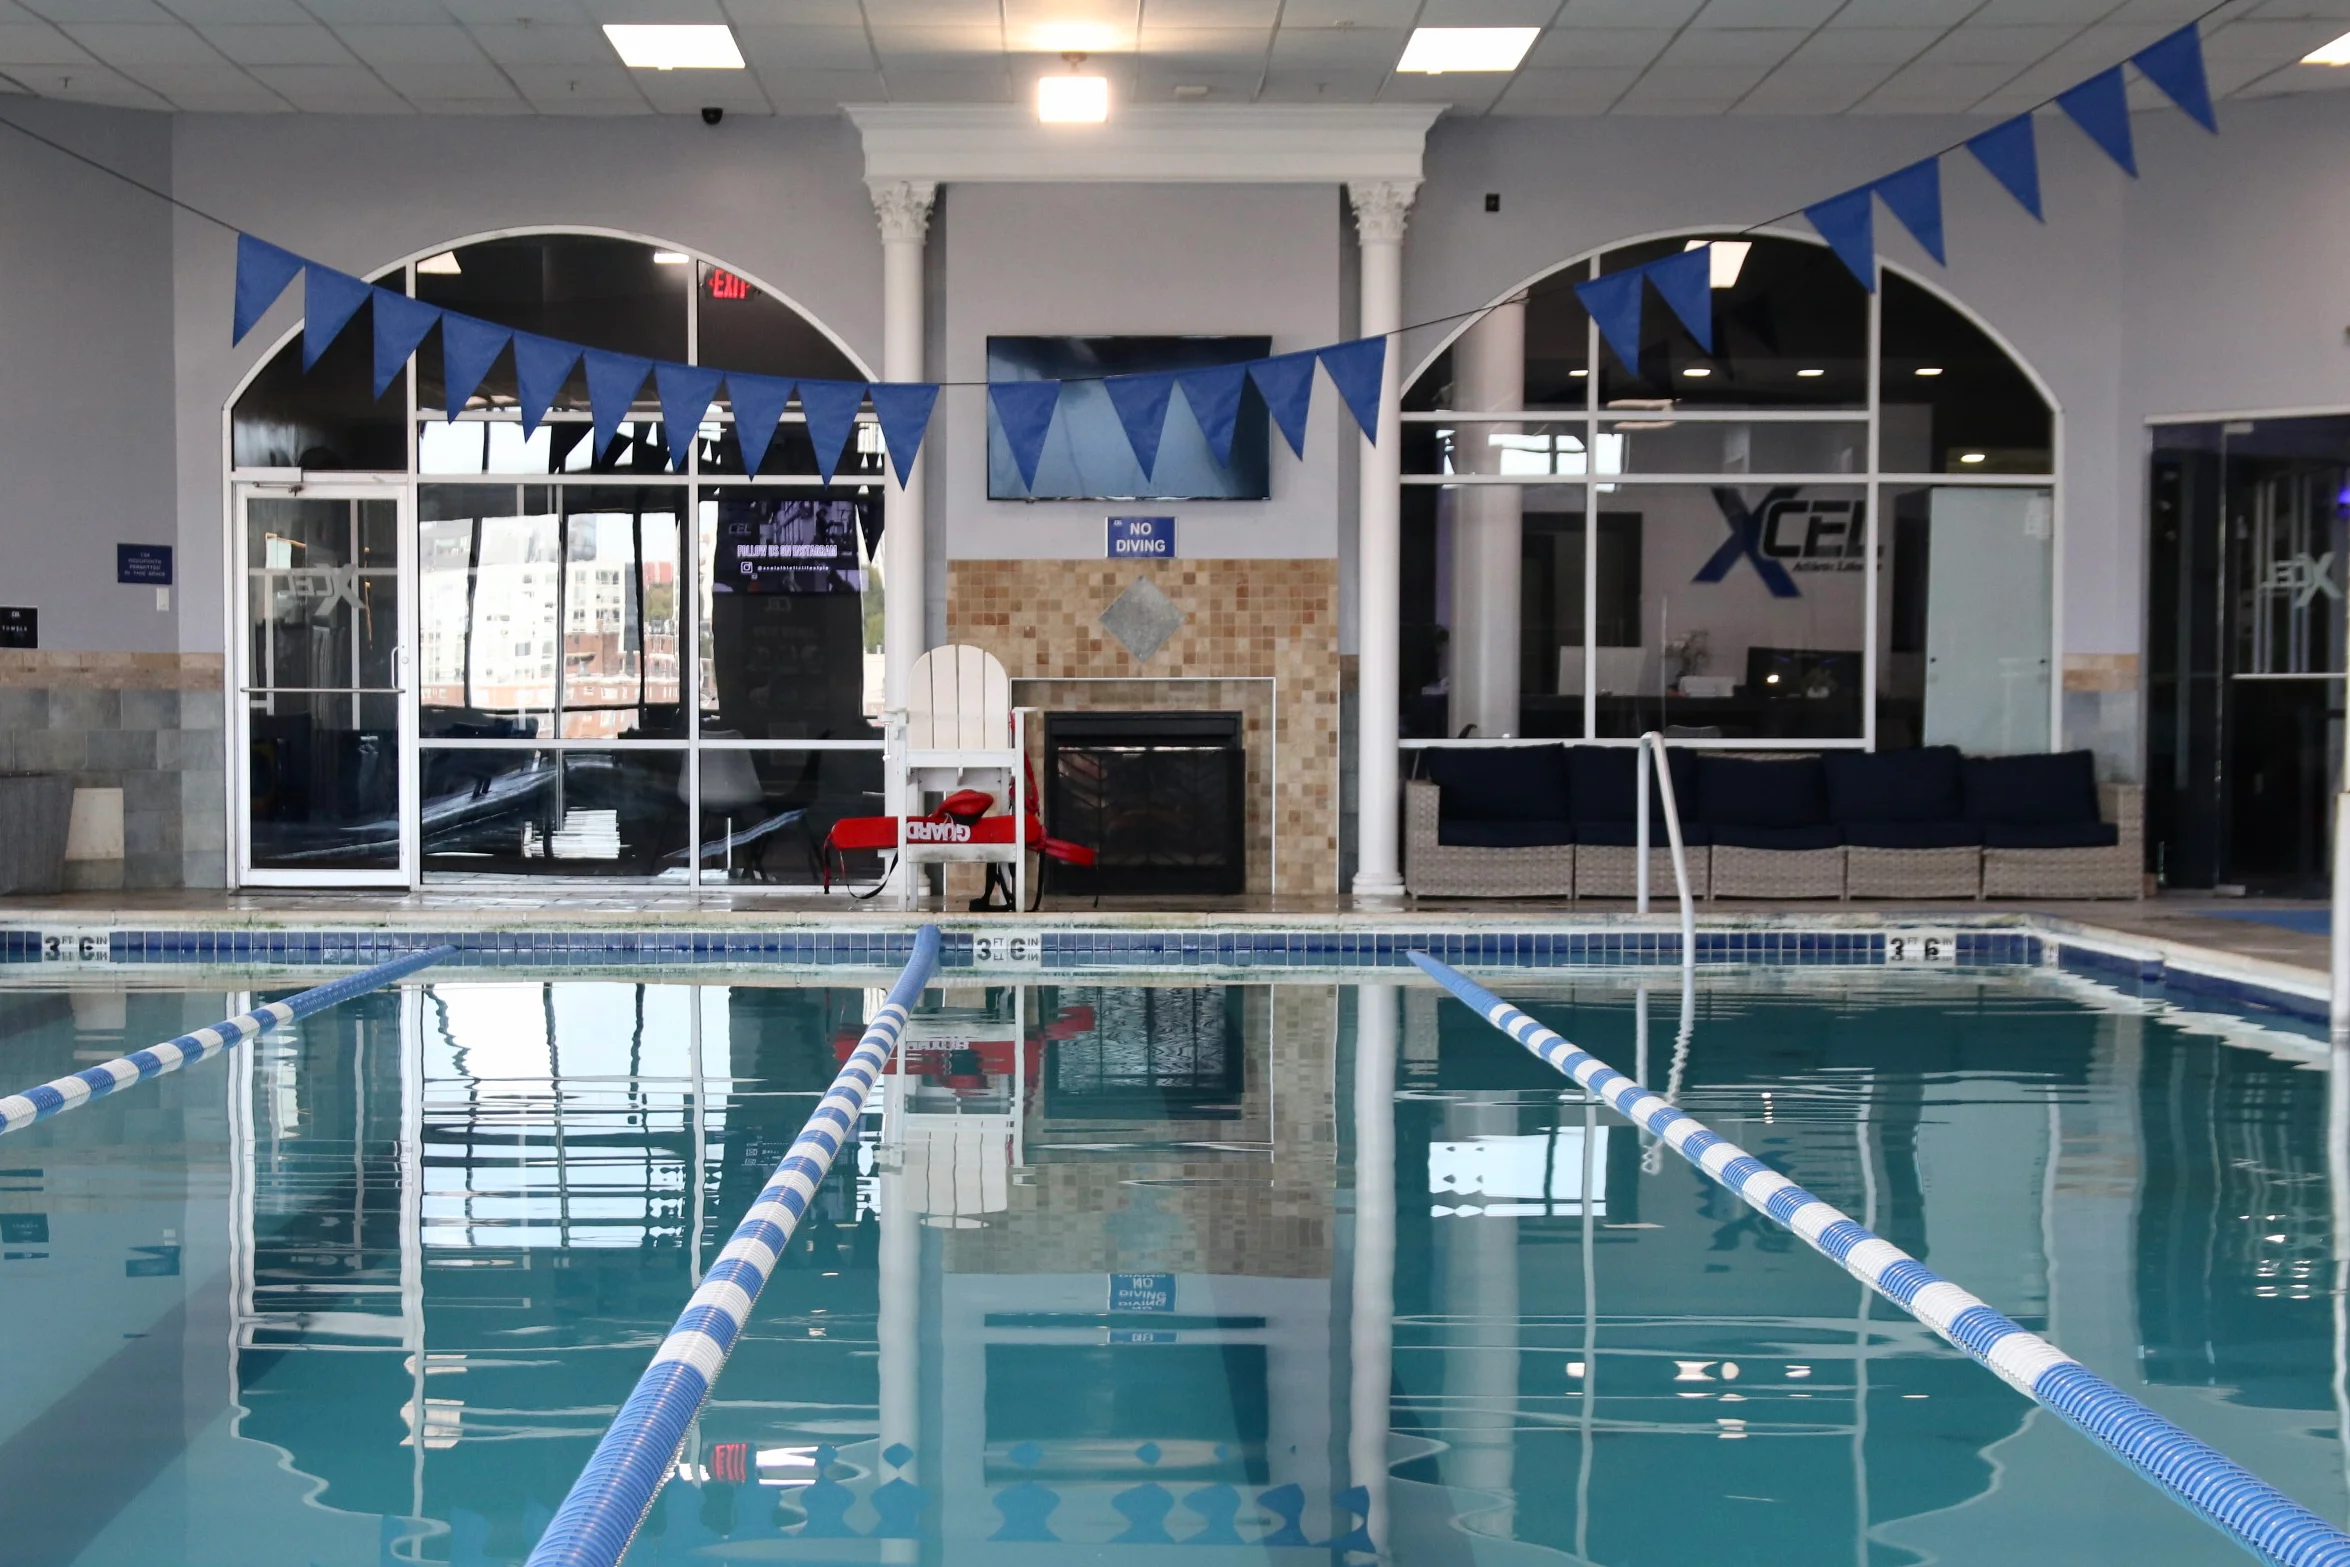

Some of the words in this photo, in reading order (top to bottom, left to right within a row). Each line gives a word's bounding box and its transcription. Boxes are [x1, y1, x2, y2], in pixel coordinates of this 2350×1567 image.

[1130, 522, 1152, 535] NO
[1116, 539, 1166, 552] DIVING
[1691, 486, 1884, 598] XCEL
[737, 544, 767, 557] FOLLOW
[768, 544, 779, 557] US
[780, 544, 792, 557] ON
[792, 544, 838, 557] INSTAGRAM
[906, 821, 971, 842] GUARD
[993, 937, 1005, 946] FT
[1027, 937, 1039, 946] IN
